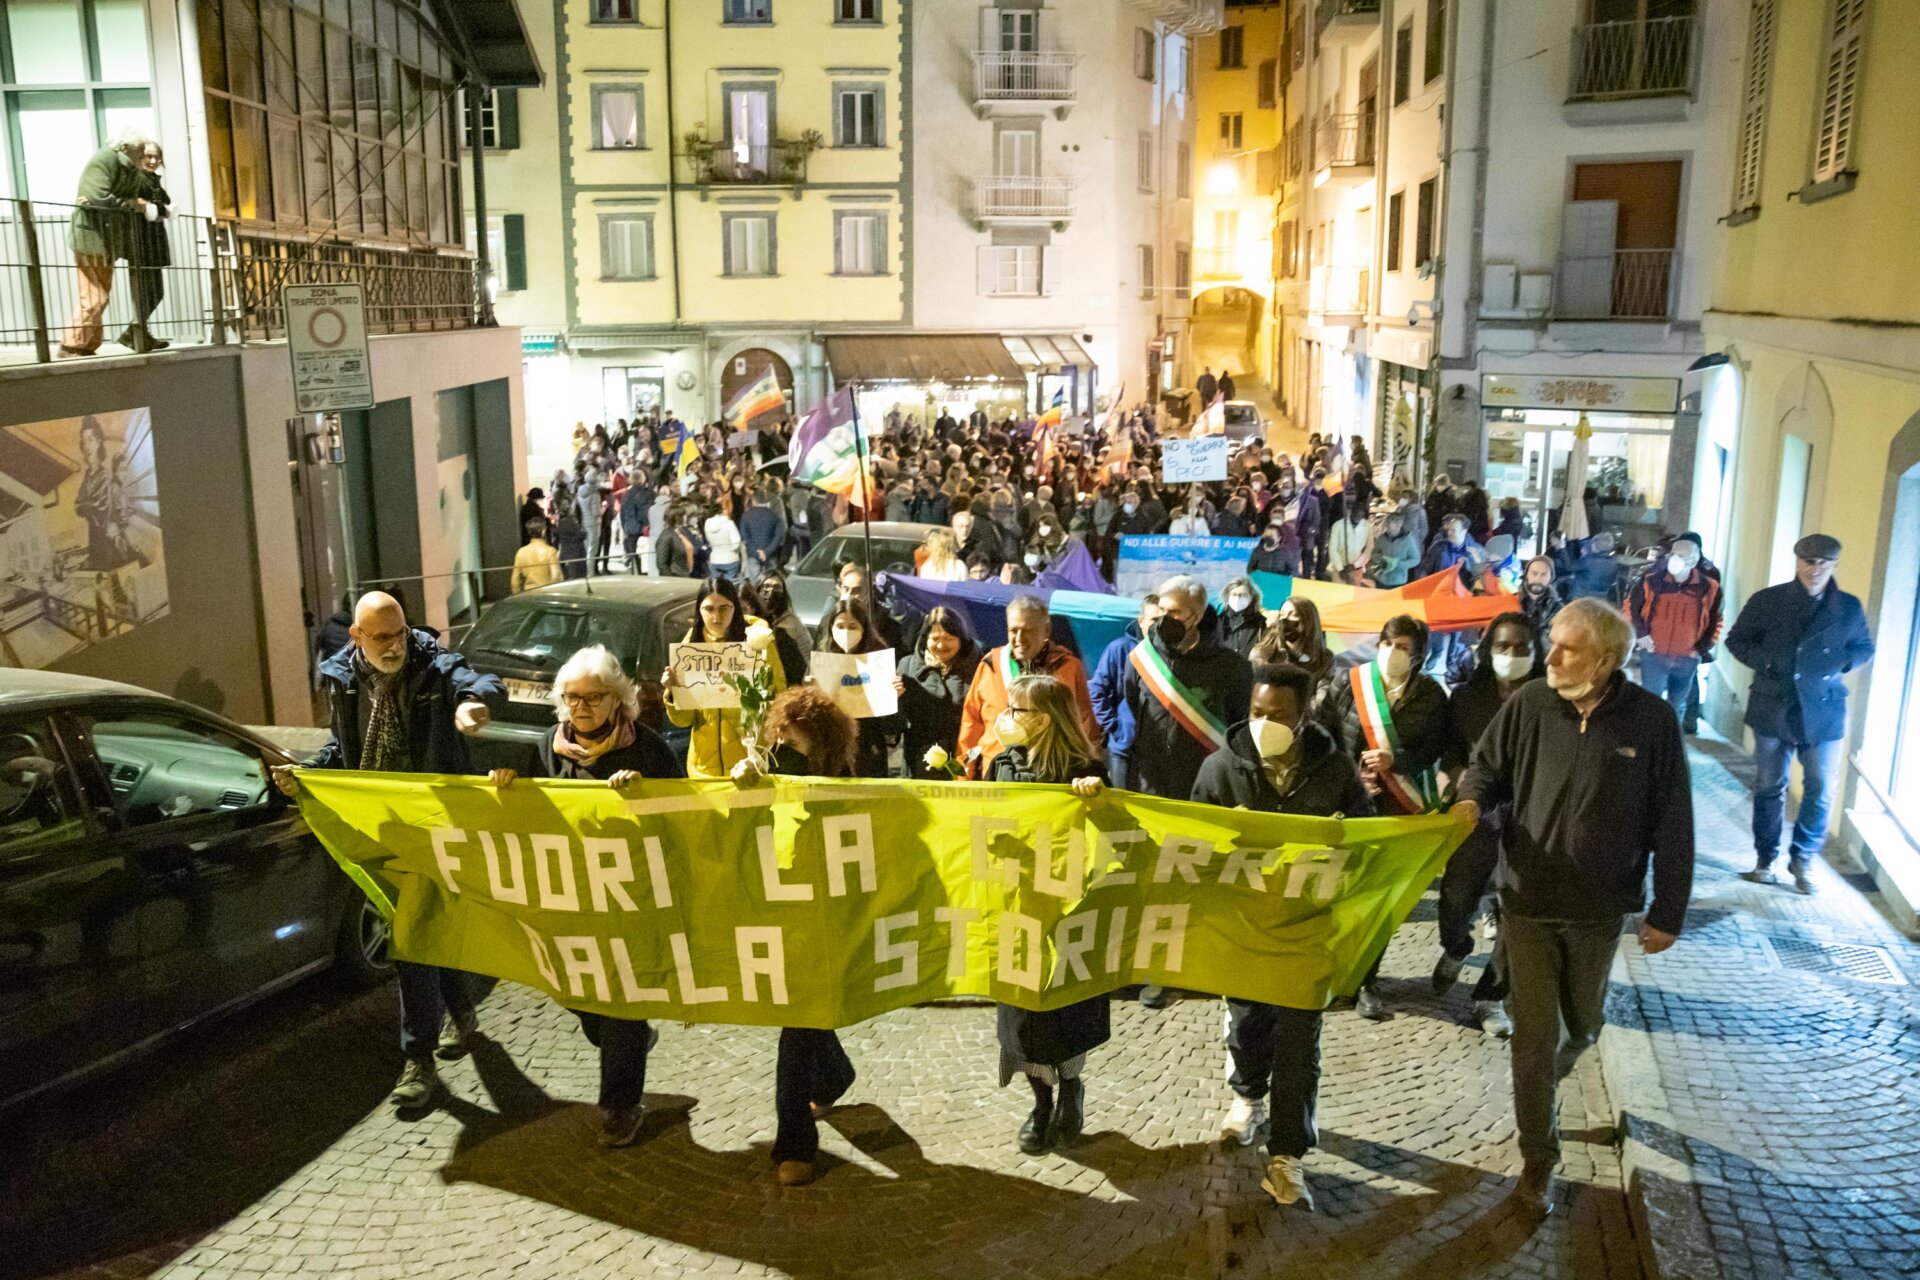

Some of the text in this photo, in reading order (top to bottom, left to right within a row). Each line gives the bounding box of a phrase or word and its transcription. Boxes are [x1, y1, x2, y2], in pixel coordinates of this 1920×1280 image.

[311, 289, 338, 297] ZONA
[291, 297, 326, 306] TRAFFICO
[1123, 538, 1138, 548] NO
[1141, 538, 1167, 548] ALLE
[1170, 538, 1211, 549] GUERRE
[1214, 539, 1222, 548] E
[430, 813, 1351, 913] FUORI LA GUERRA
[874, 902, 1191, 992] STORIA
